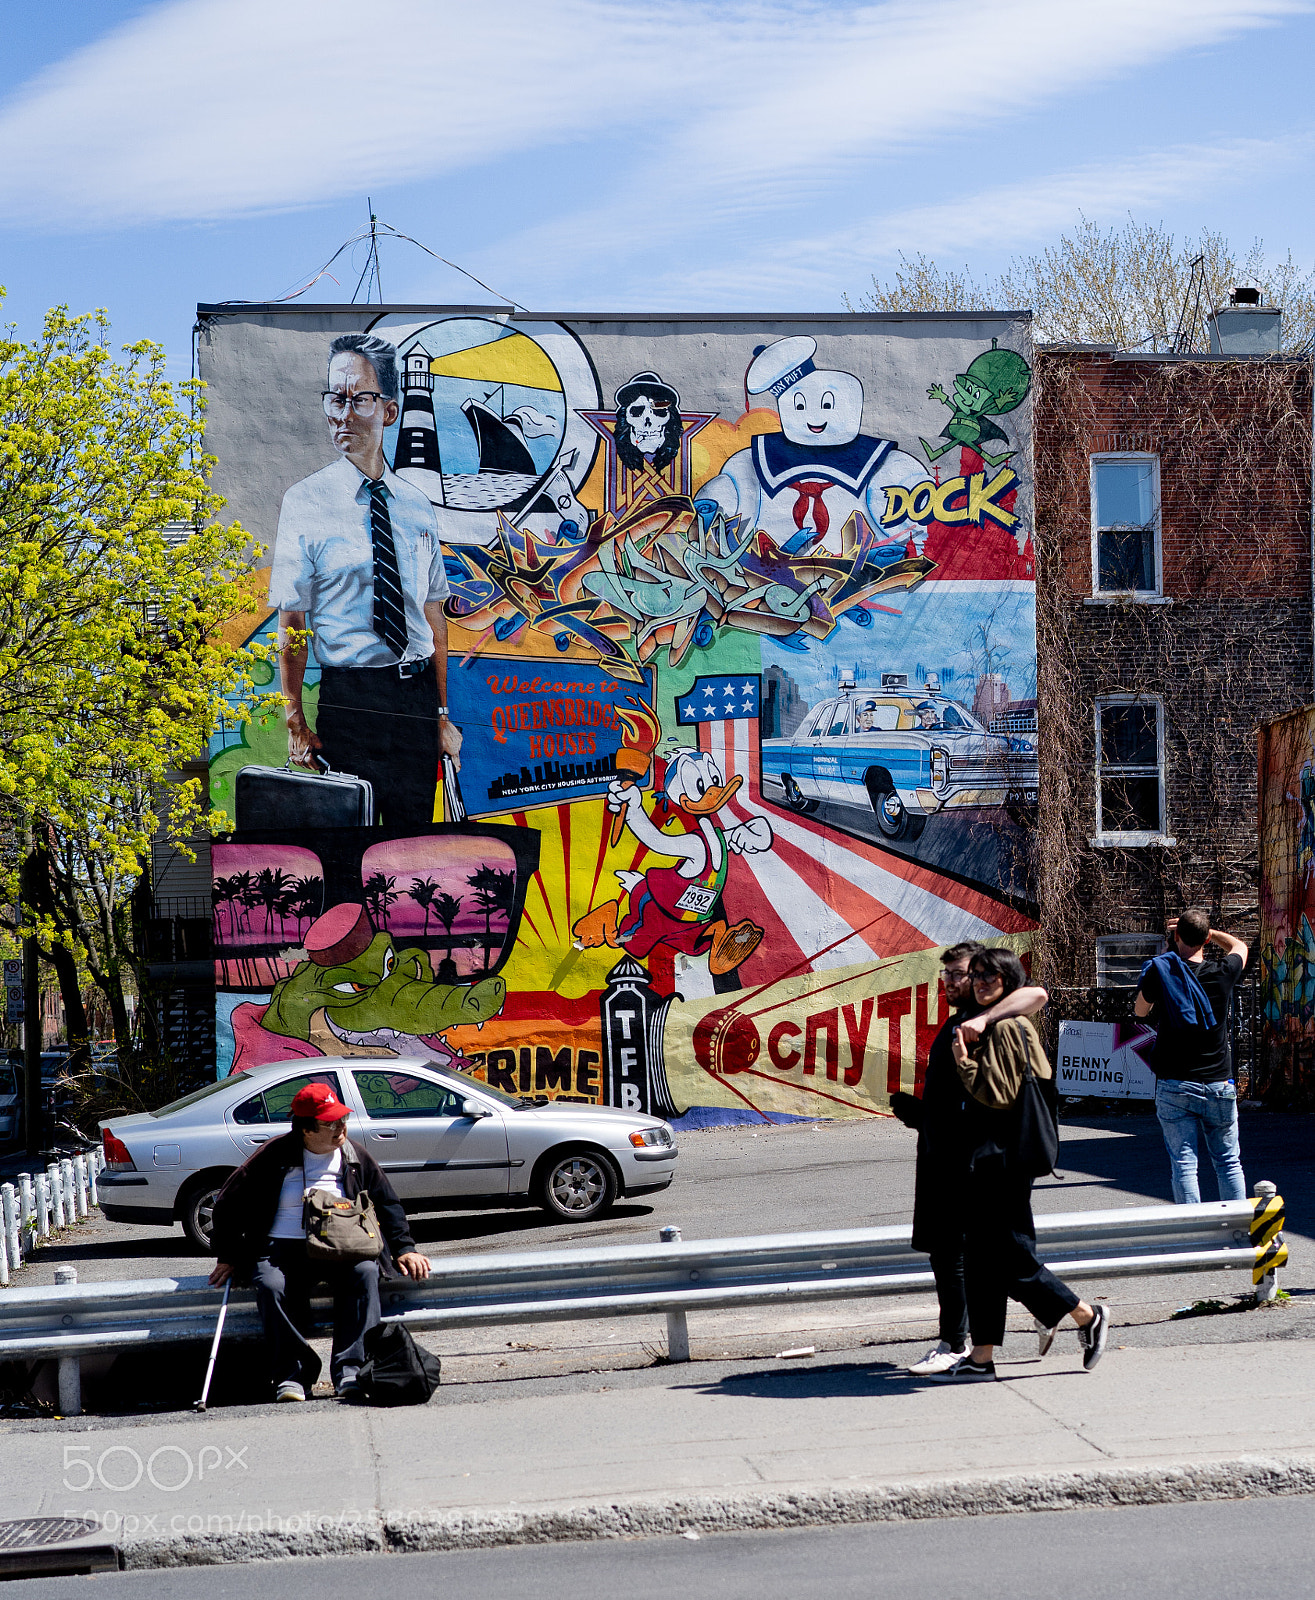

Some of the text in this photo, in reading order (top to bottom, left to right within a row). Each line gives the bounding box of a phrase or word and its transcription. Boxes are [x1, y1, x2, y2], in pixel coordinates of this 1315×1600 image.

[769, 367, 804, 397] STAY PUFT
[880, 466, 1023, 536] DOCK
[486, 674, 595, 695] Welcome
[528, 731, 597, 759] HOUSES
[502, 788, 519, 796] NEW
[519, 783, 541, 793] YORK
[541, 782, 556, 791] CITY
[557, 779, 586, 788] HOUSING
[683, 891, 711, 909] 1992
[767, 977, 951, 1100] СПУТН
[1062, 1056, 1111, 1070] BENNY
[1061, 1068, 1124, 1083] WILDING
